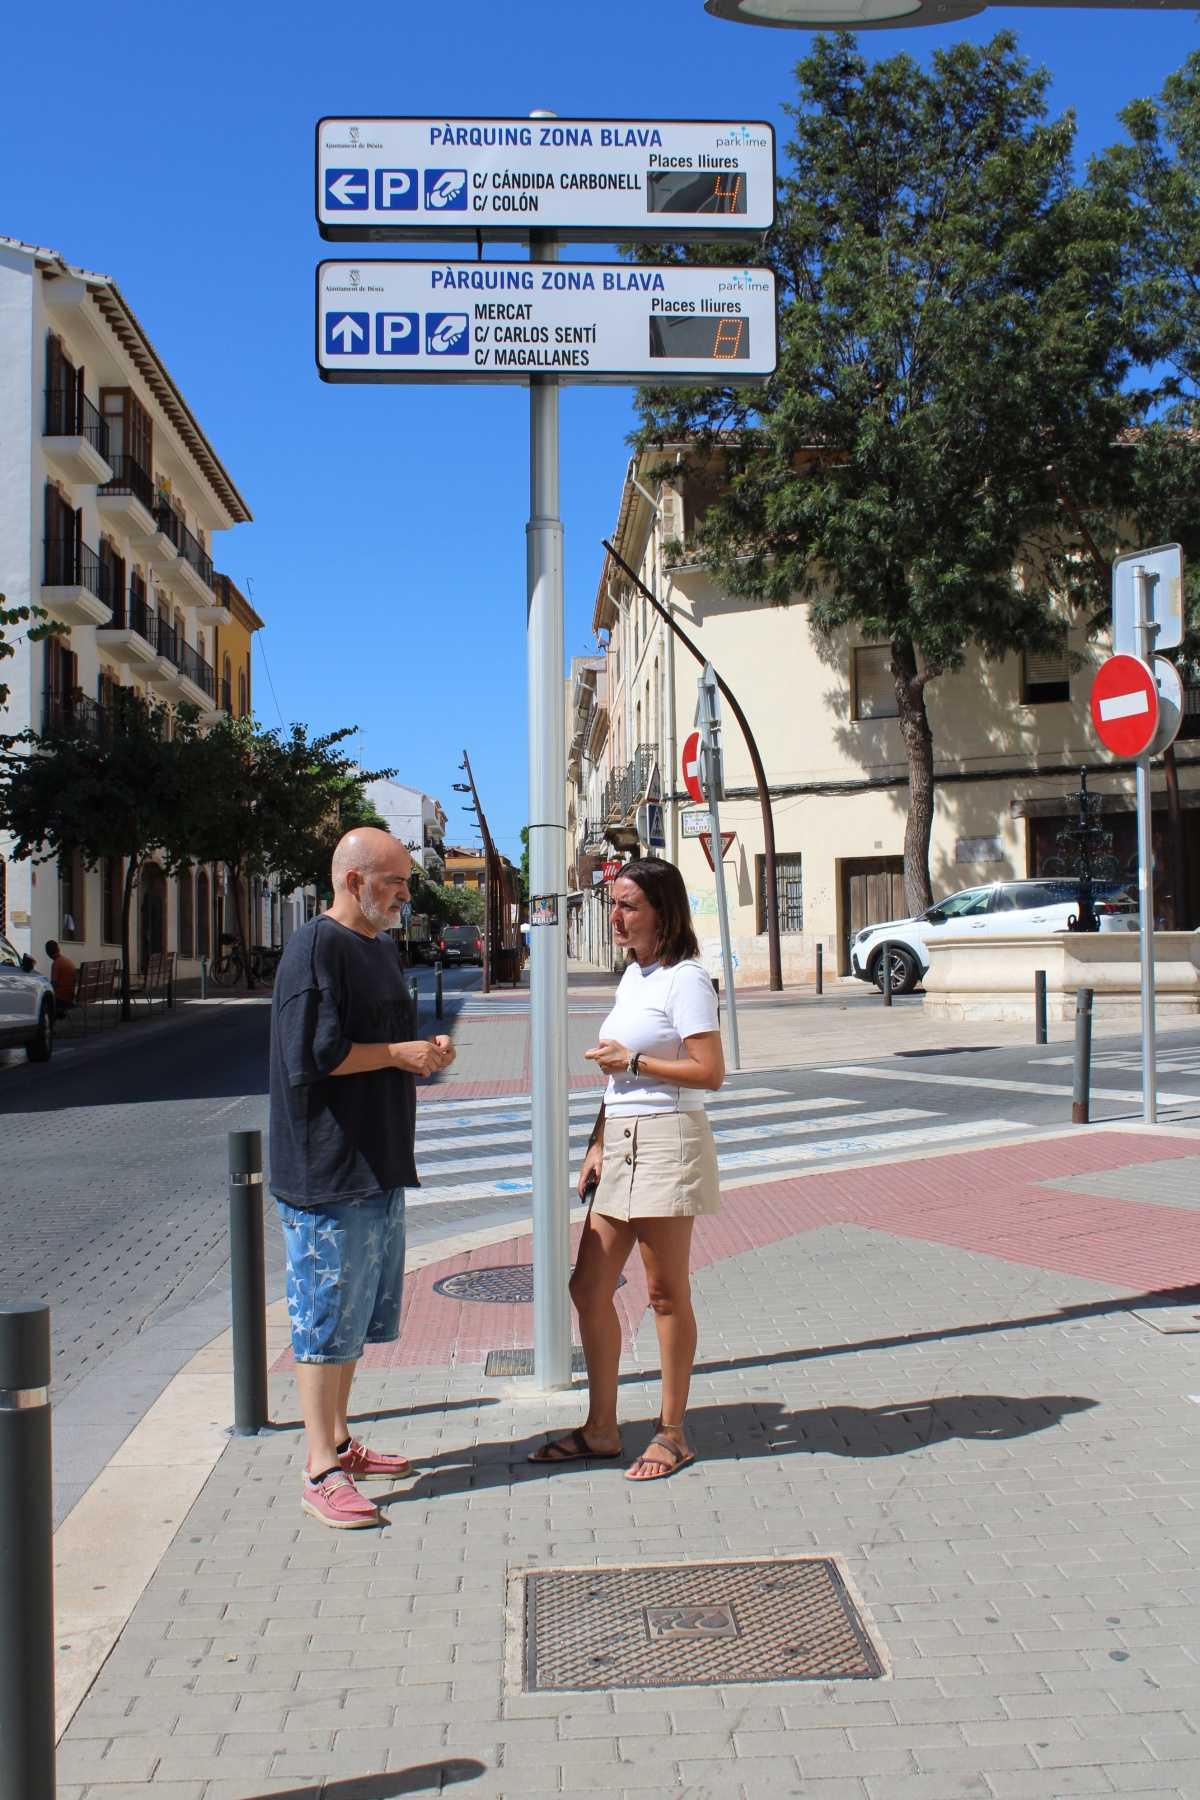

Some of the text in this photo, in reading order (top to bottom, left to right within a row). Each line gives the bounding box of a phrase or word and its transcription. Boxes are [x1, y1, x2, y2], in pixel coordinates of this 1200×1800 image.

[430, 124, 663, 147] PÀRQUING ZONA BLAVA
[649, 154, 739, 168] Places lliures
[382, 171, 411, 208] P
[473, 169, 642, 190] C/ CÁNDIDA CARBONELL
[473, 192, 539, 212] C/ COLÓN
[714, 175, 741, 213] 4
[431, 266, 665, 291] PÀRQUING ZONA BLAVA
[474, 304, 533, 320] MERCAT
[651, 298, 742, 313] Places lliures
[383, 315, 412, 352] P
[474, 323, 596, 343] C/ CARLOS SENTÍ
[713, 319, 743, 358] 8
[474, 349, 589, 366] C/ MAGALLANES
